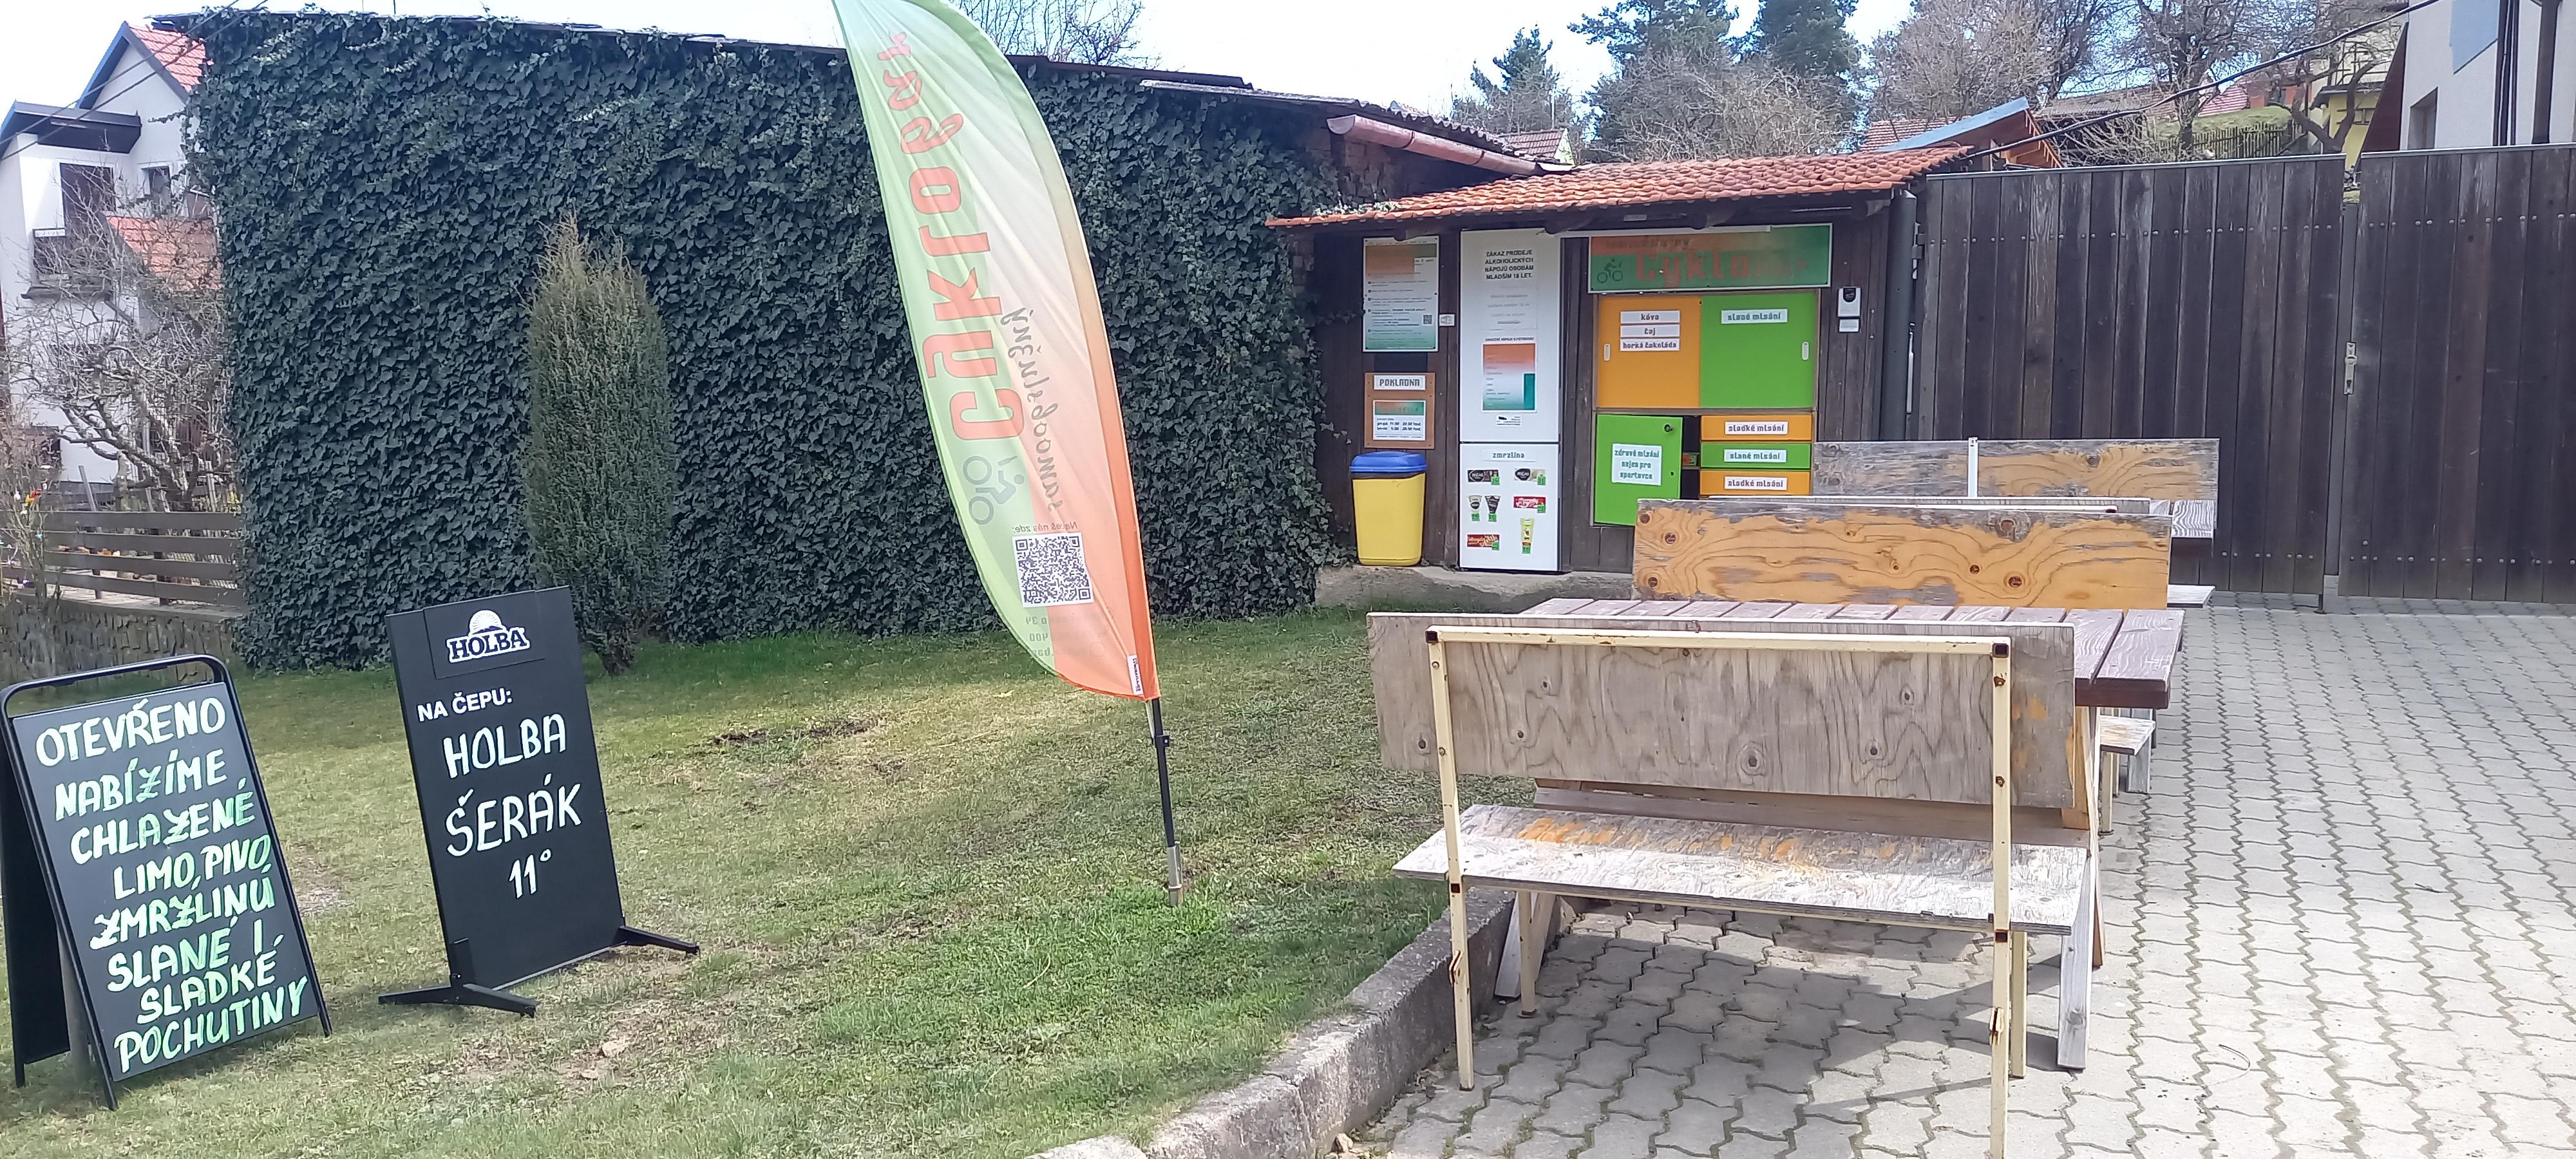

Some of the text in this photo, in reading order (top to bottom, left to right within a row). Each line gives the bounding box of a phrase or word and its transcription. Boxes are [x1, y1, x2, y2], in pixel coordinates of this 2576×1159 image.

[449, 628, 528, 660] HOLBA
[36, 697, 225, 767] OTEVŘENO
[417, 687, 513, 722] NA ČEPU:
[442, 713, 566, 779] HOLBA
[55, 748, 227, 821] NABÍZÍME
[70, 777, 255, 864] CHLAZENÉ
[445, 773, 582, 857] ŠERÁK
[90, 876, 275, 950] ZMRZLINU
[108, 915, 238, 992] SLANÉ
[137, 934, 284, 1024] SLADKÉ
[114, 975, 308, 1073] POCHUTINY
